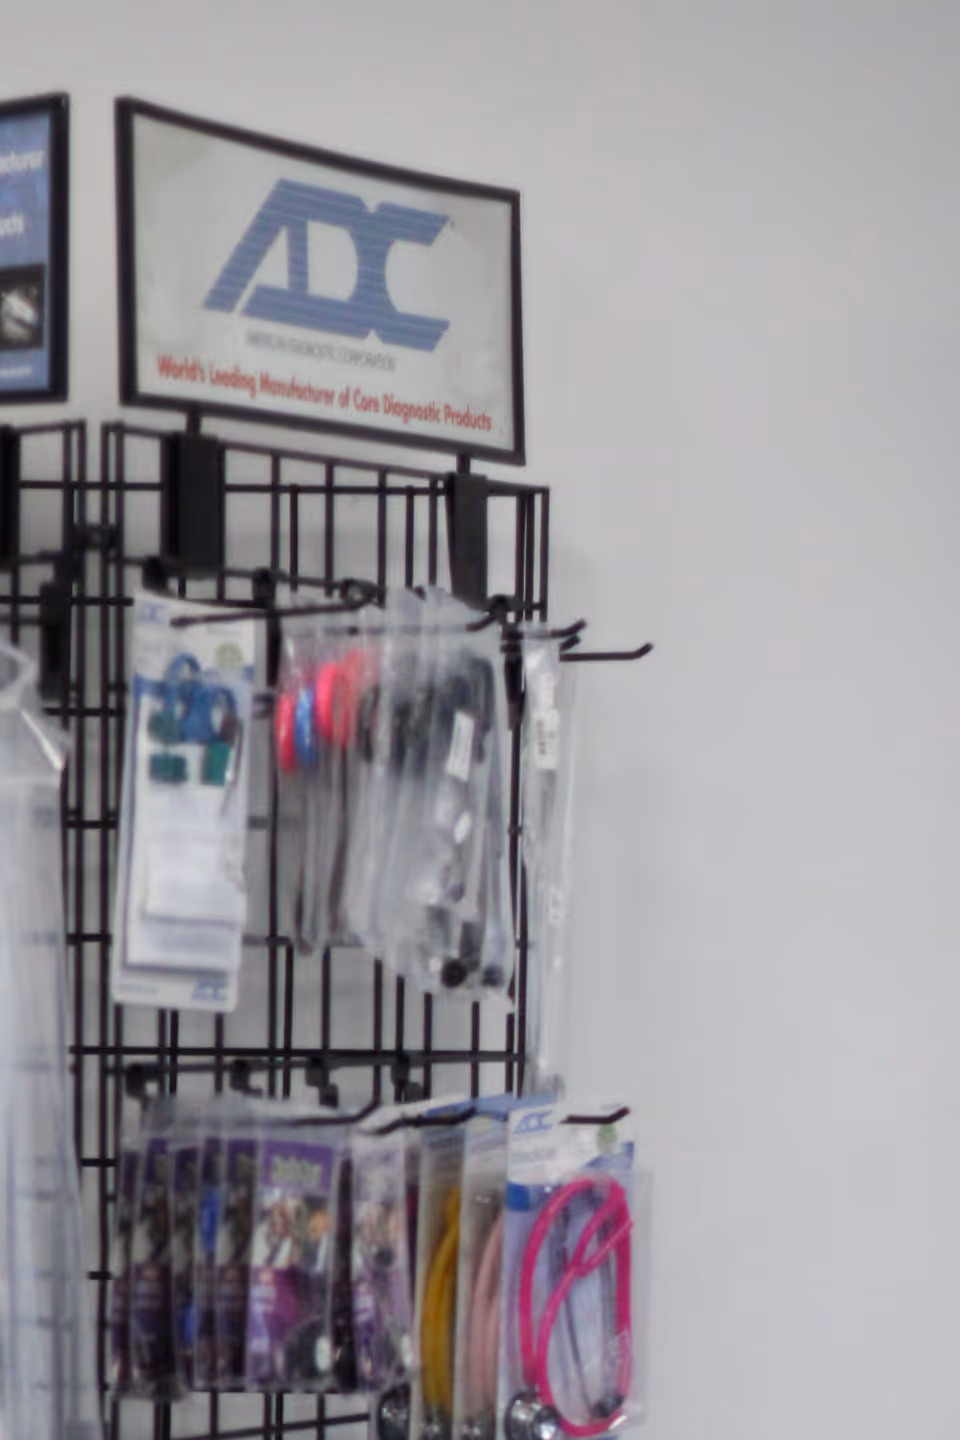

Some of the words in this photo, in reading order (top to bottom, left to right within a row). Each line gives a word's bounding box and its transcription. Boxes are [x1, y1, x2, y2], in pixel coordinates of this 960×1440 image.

[200, 178, 451, 352] ADC
[210, 363, 256, 399] Leading
[259, 370, 334, 407] Manufacturer
[339, 385, 350, 409] of
[382, 393, 441, 425] Diagnostic
[444, 404, 492, 431] Products
